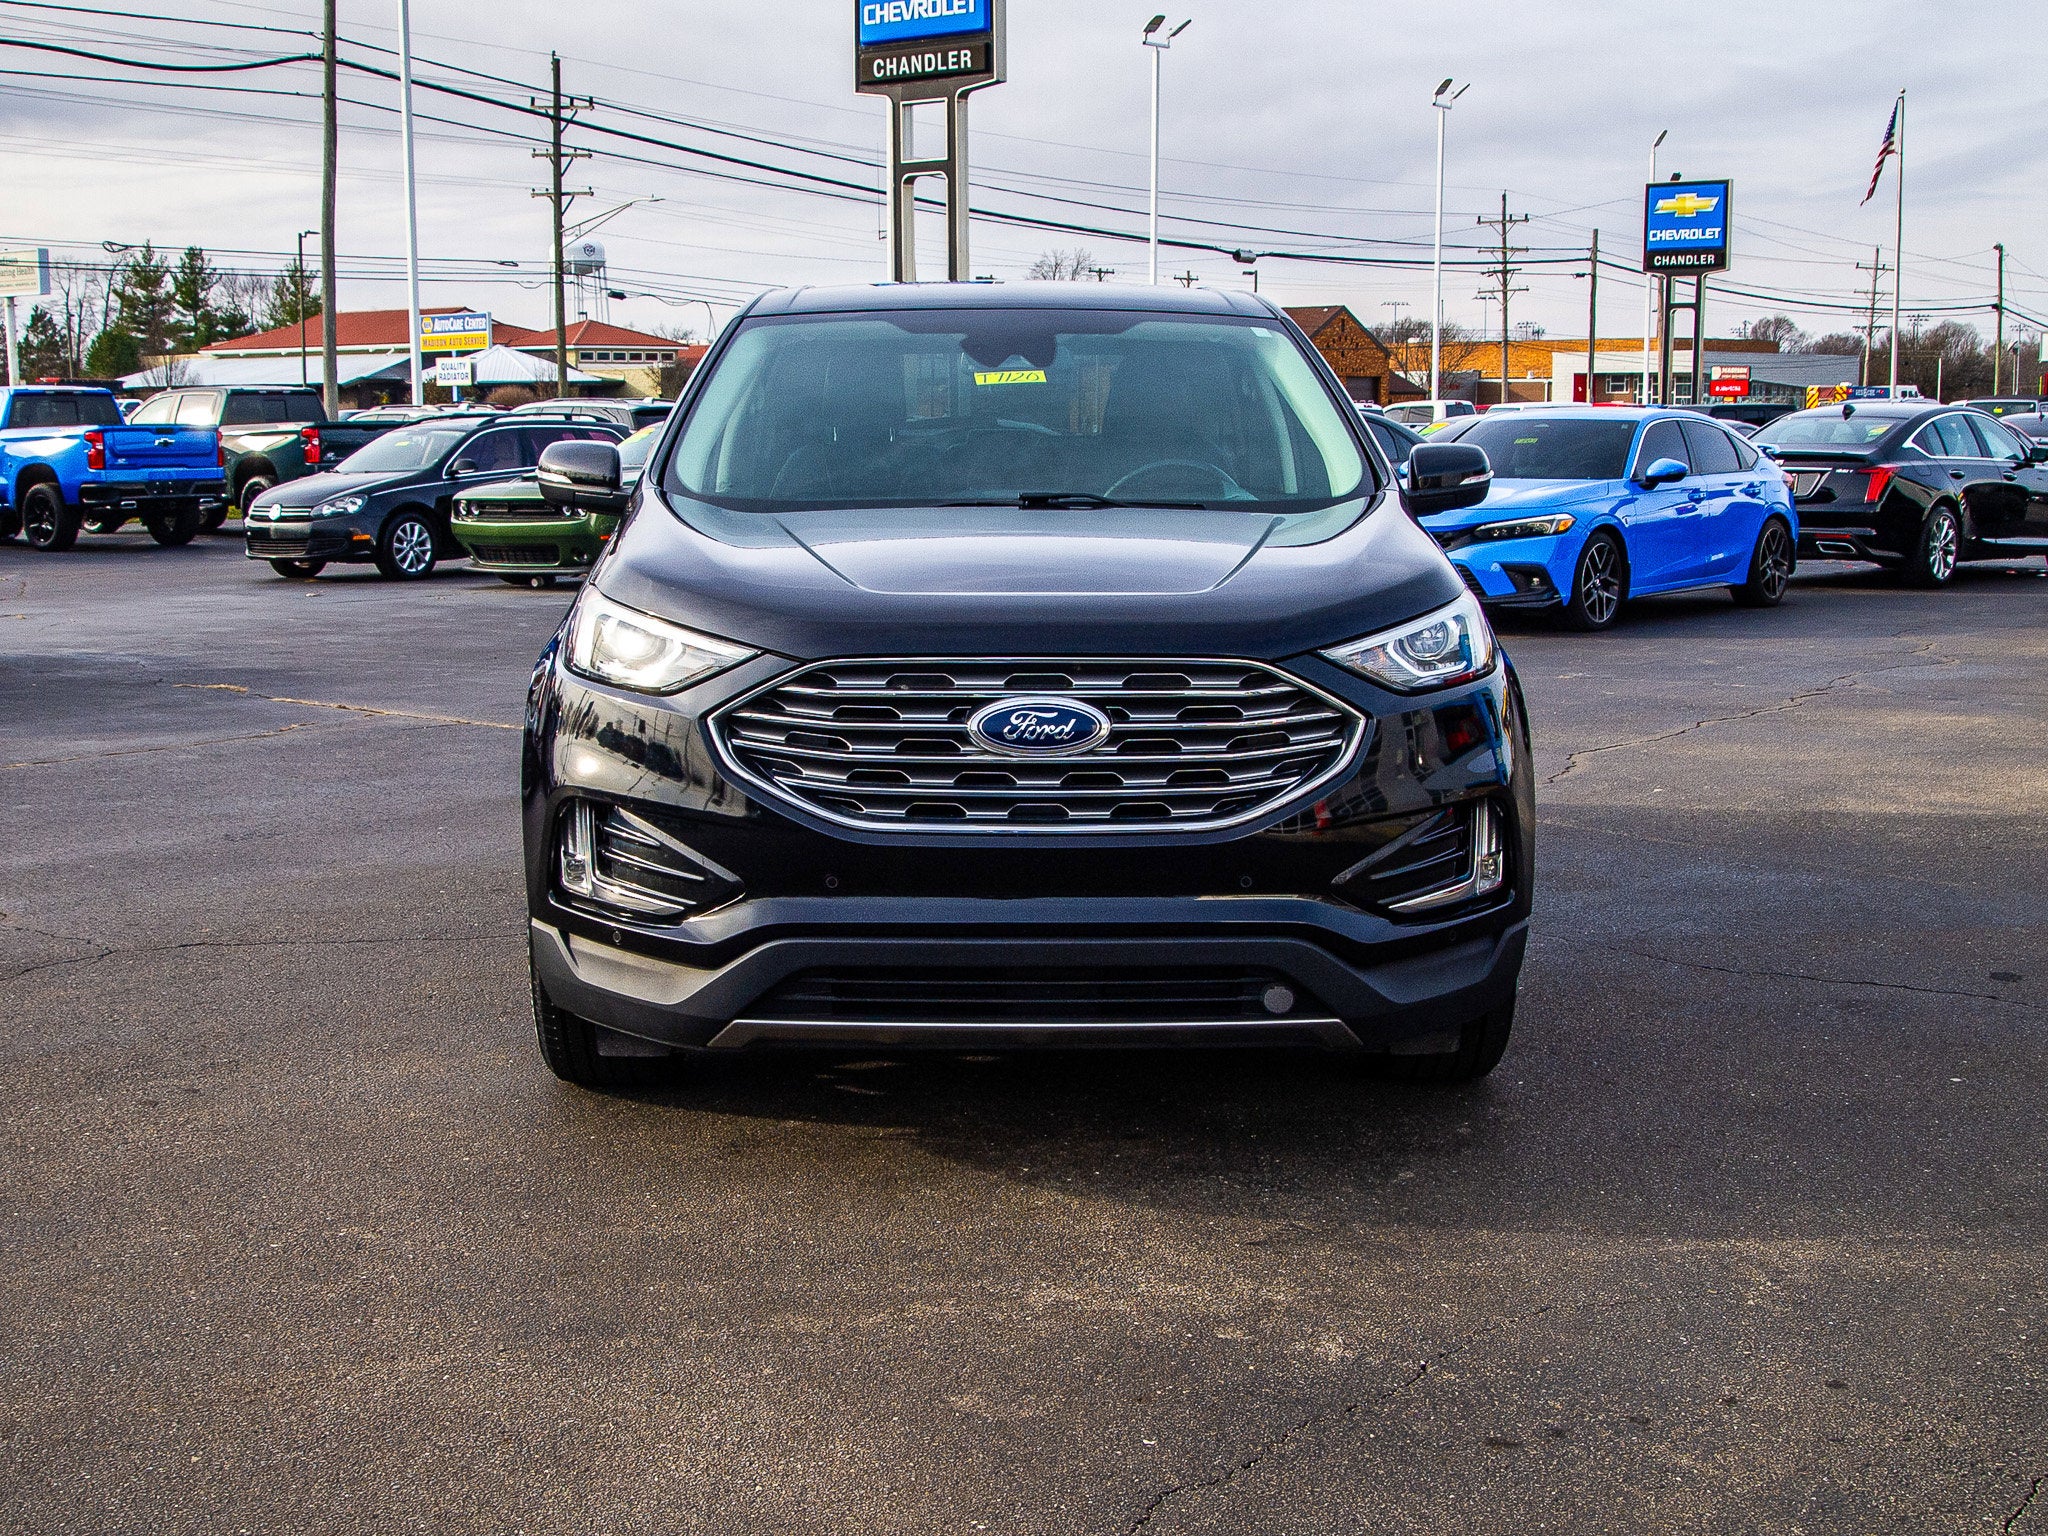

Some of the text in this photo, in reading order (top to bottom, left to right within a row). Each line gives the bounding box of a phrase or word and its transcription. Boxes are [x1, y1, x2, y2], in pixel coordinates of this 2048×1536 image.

[873, 49, 972, 78] CHANDLER
[1649, 228, 1721, 241] CHEVROLET
[1654, 254, 1715, 266] CHANDLER
[449, 337, 462, 346] AUTO
[464, 337, 486, 345] SERVICE
[440, 362, 466, 371] QUALITY
[439, 372, 469, 381] RADIATOR
[1003, 710, 1077, 740] Ford
